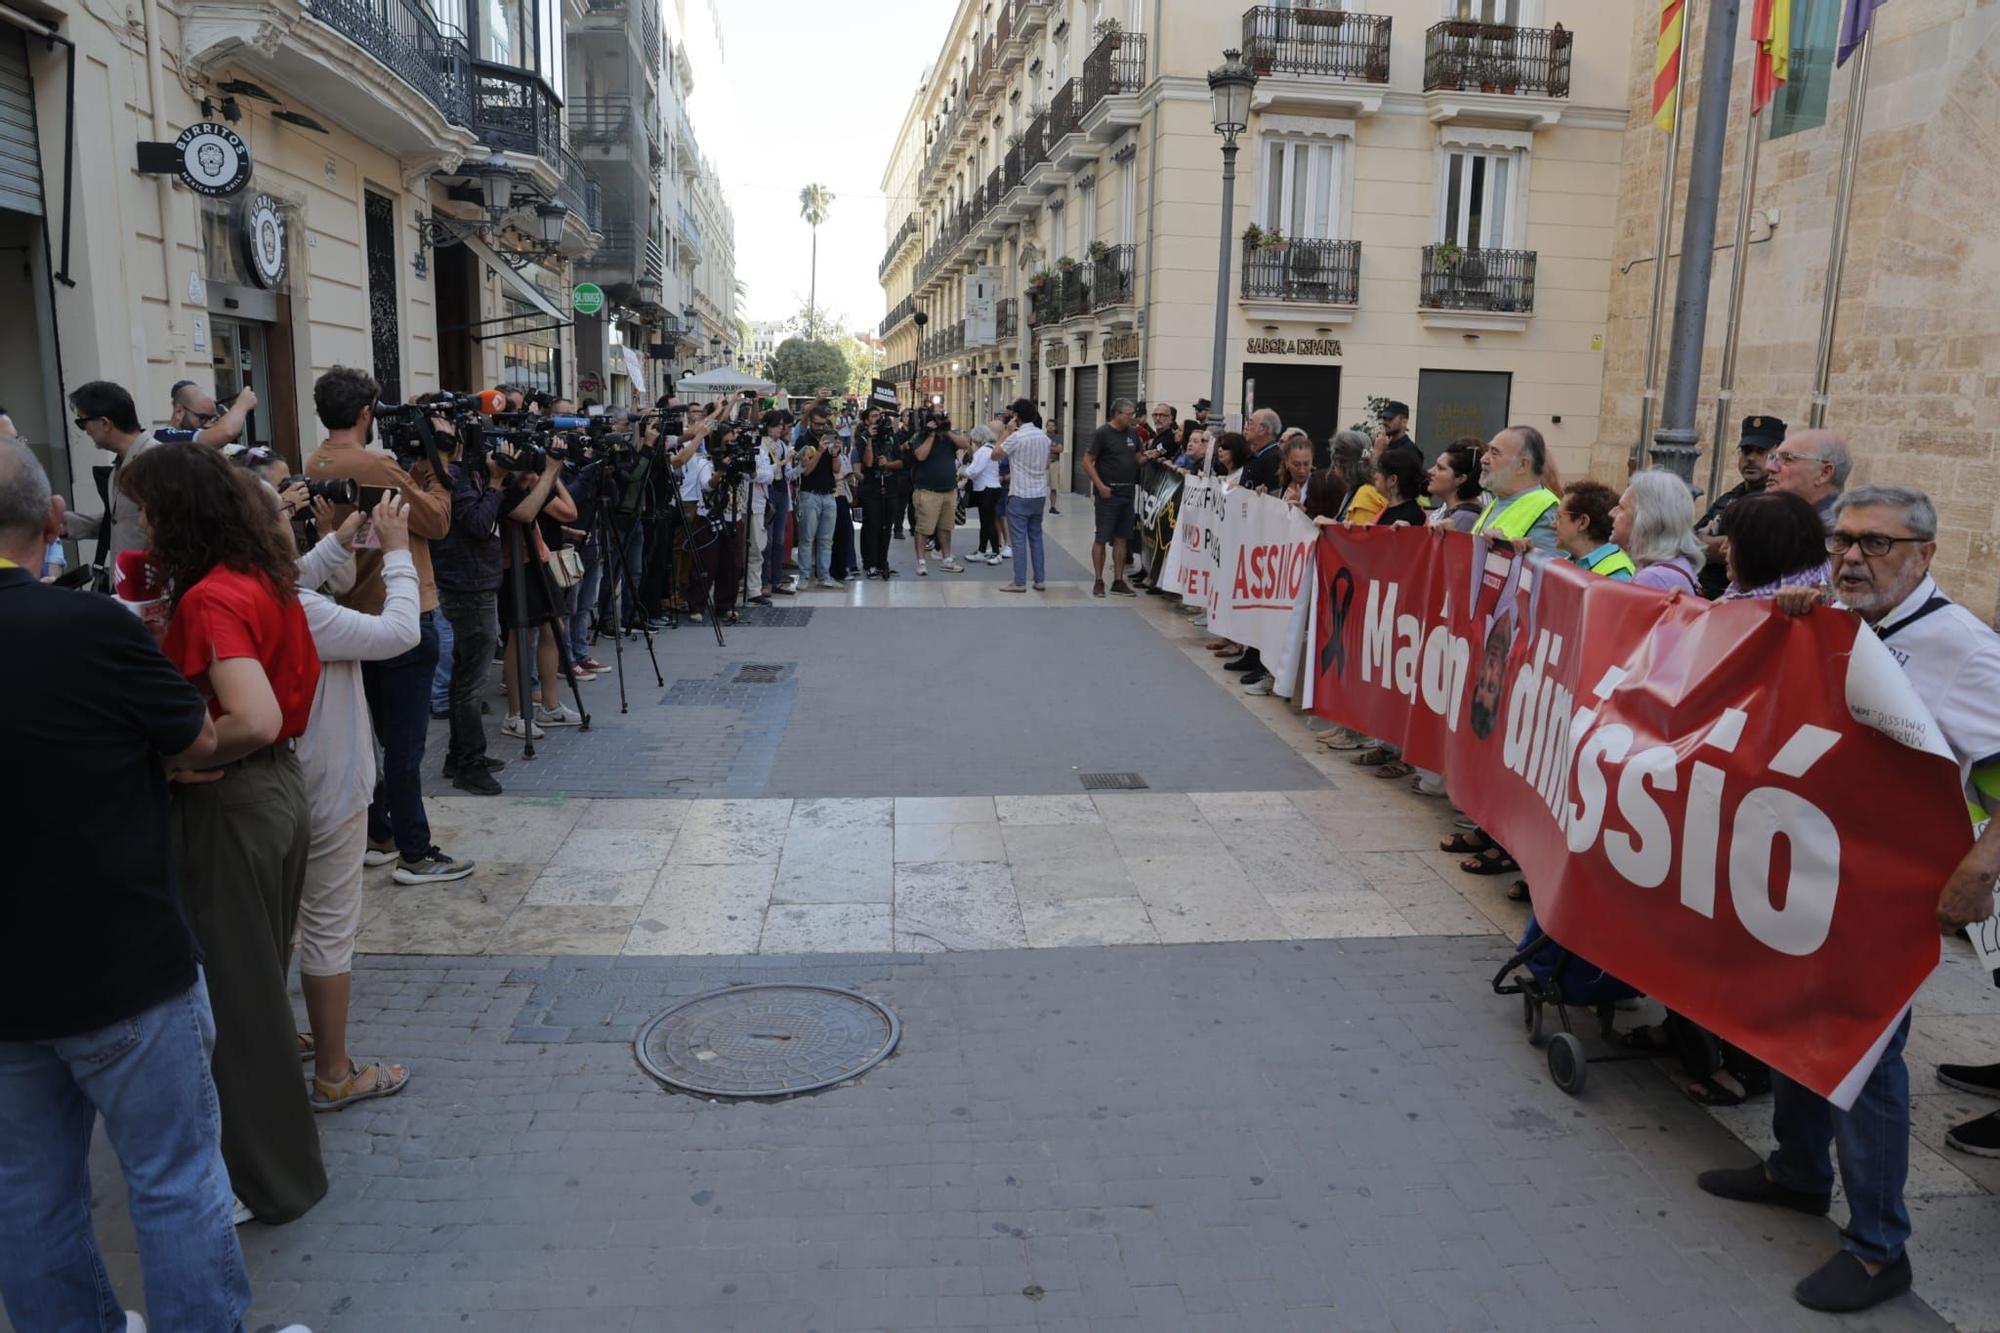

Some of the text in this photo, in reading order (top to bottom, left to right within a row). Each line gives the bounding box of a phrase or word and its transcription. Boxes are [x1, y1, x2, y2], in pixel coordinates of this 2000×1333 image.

[176, 123, 247, 155] BURRITOS
[181, 171, 244, 195] MEXICAN GRILL
[1246, 338, 1287, 354] SABOR
[1361, 579, 1470, 733] Maón
